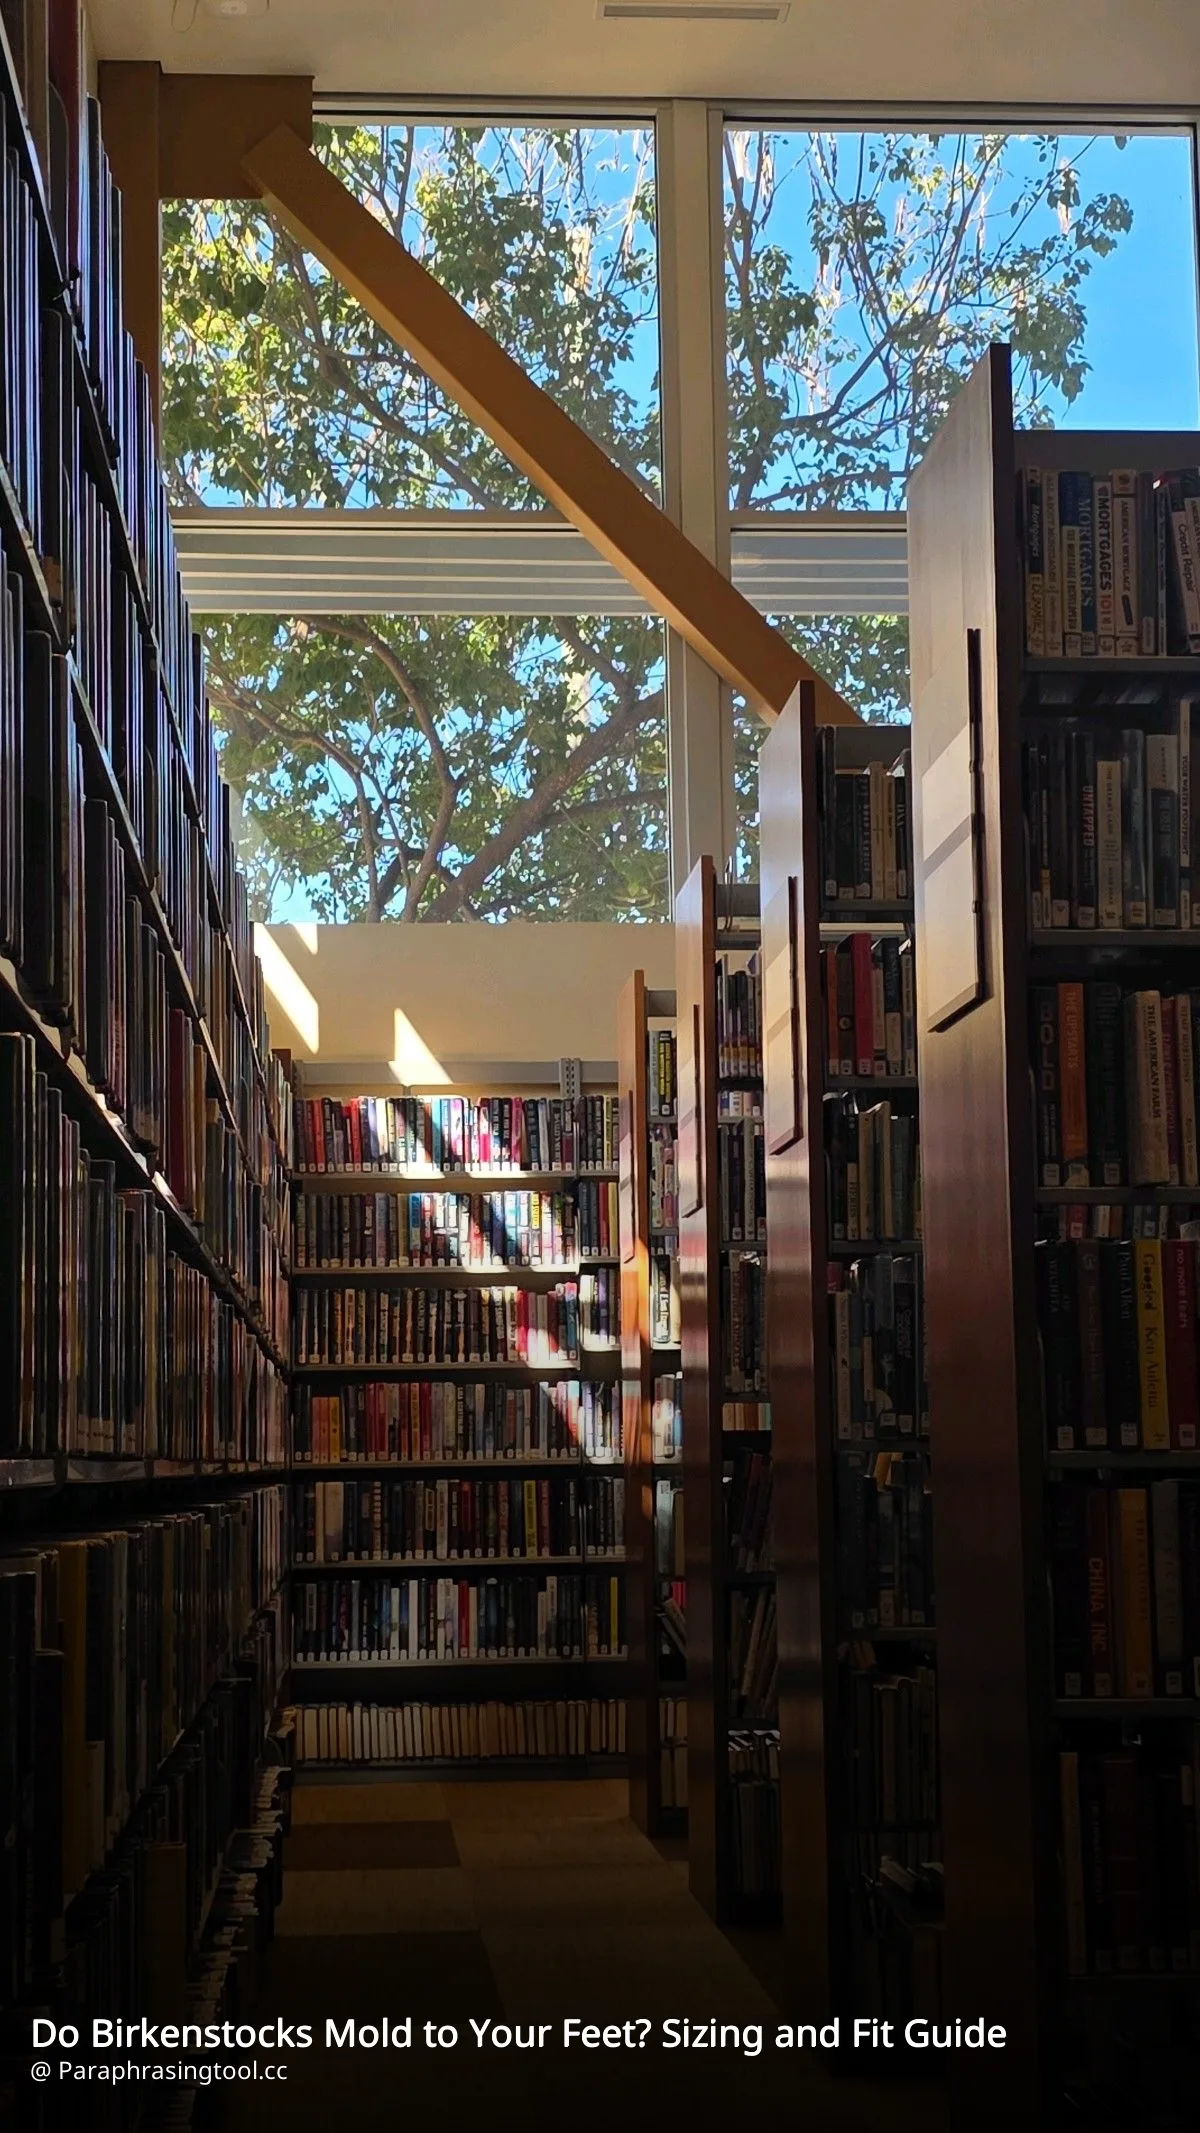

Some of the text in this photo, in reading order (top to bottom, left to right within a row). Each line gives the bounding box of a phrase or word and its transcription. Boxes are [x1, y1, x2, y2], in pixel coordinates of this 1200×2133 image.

[1031, 503, 1041, 558] Mortgages
[1078, 498, 1094, 608] MORTGAGES
[1097, 497, 1112, 591] MORTGAGES
[1178, 523, 1190, 555] Credit
[1182, 558, 1196, 593] Repair
[1082, 784, 1095, 848] UNTAPPED
[1182, 808, 1190, 856] FOOTPRINT
[1040, 1001, 1056, 1092] BOLD
[1066, 989, 1080, 1070] THE UPSTARTS
[1147, 1004, 1162, 1119] THE AMERICAN FARM
[1118, 1250, 1132, 1280] Paul
[1175, 1248, 1185, 1265] no
[1176, 1267, 1187, 1297] more
[1120, 1284, 1133, 1320] Allen
[1142, 1253, 1160, 1408] Googled Ken Auletta
[1088, 1556, 1109, 1656] CHINA INC.
